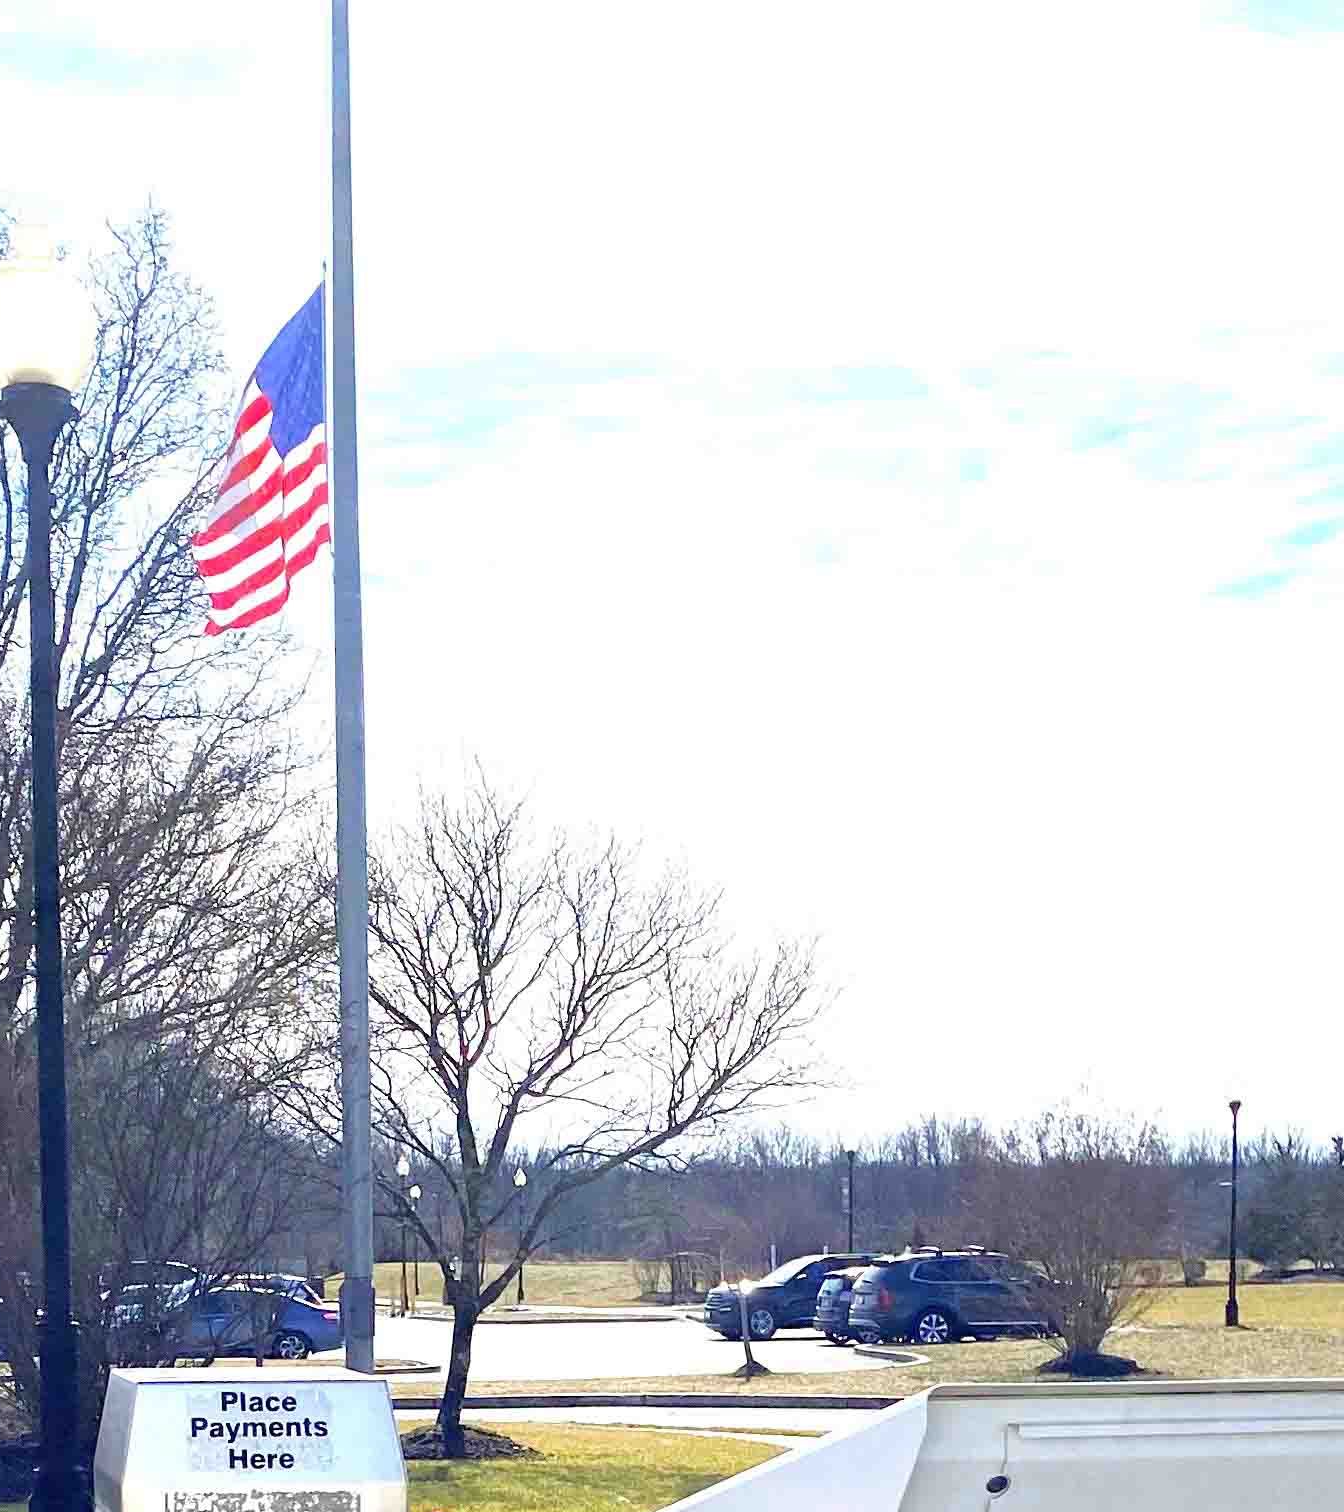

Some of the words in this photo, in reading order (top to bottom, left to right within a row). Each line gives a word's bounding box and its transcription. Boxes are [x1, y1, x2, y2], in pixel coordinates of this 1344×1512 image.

[220, 1391, 297, 1412] Place
[191, 1417, 328, 1443] Payments
[229, 1448, 295, 1470] Here
